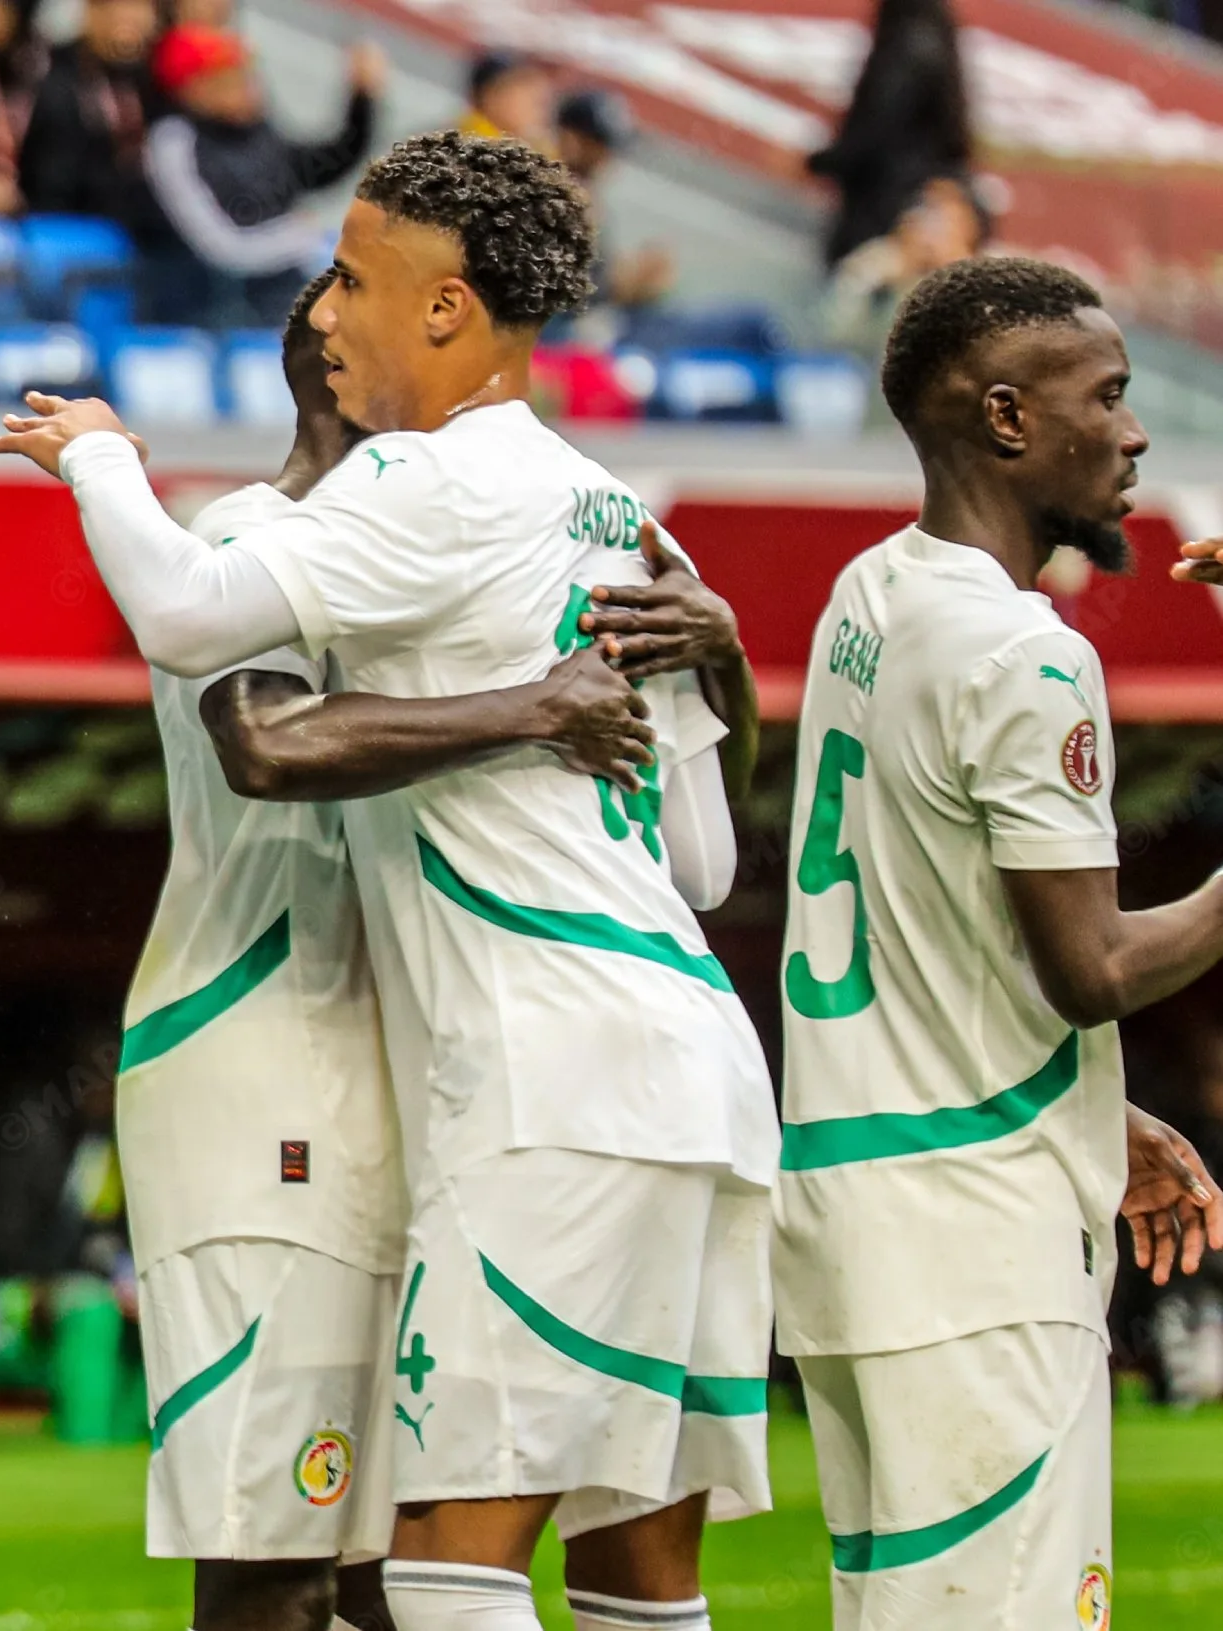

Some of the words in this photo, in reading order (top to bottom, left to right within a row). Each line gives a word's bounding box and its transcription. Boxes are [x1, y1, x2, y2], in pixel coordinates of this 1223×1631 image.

[566, 486, 650, 551] JAKOB
[829, 617, 884, 697] GANA
[785, 727, 877, 1020] 5
